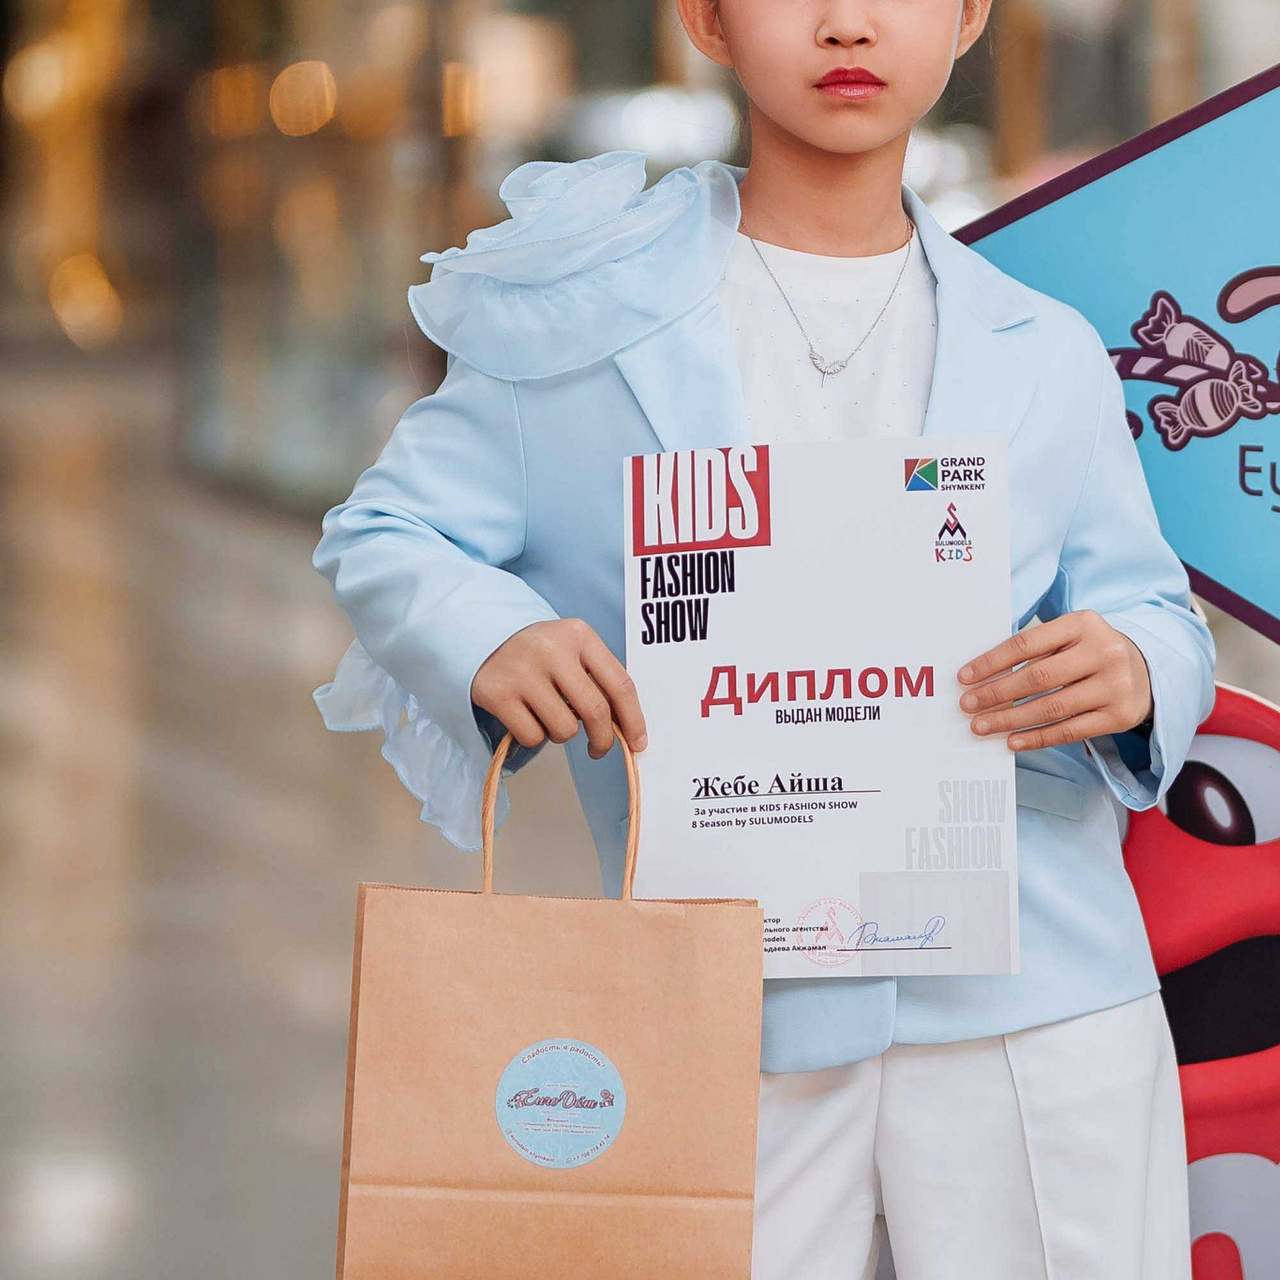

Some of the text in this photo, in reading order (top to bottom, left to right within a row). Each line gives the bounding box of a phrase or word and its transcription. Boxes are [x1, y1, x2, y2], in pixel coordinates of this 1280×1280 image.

[940, 457, 985, 467] GRAND
[941, 469, 985, 482] PARK
[643, 446, 760, 546] KIDS
[940, 483, 986, 491] SHYMKENT
[935, 546, 973, 562] KIDS
[640, 550, 735, 600] FASHION
[641, 598, 709, 645] SHOW
[701, 665, 934, 717] Диплом
[775, 705, 881, 724] ВЫДАН МОДЕЛИ
[692, 772, 844, 797] Жебе Айша
[694, 807, 706, 815] За
[708, 804, 748, 816] участие
[759, 803, 781, 812] KIDS
[783, 801, 826, 811] FASHION
[828, 800, 858, 810] SHOW
[937, 779, 1008, 823] SHOW
[691, 814, 814, 828] 8 Season by SULUMODELS
[904, 825, 1002, 870] FASHION
[763, 917, 781, 925] ктор
[521, 1044, 561, 1064] Сладость
